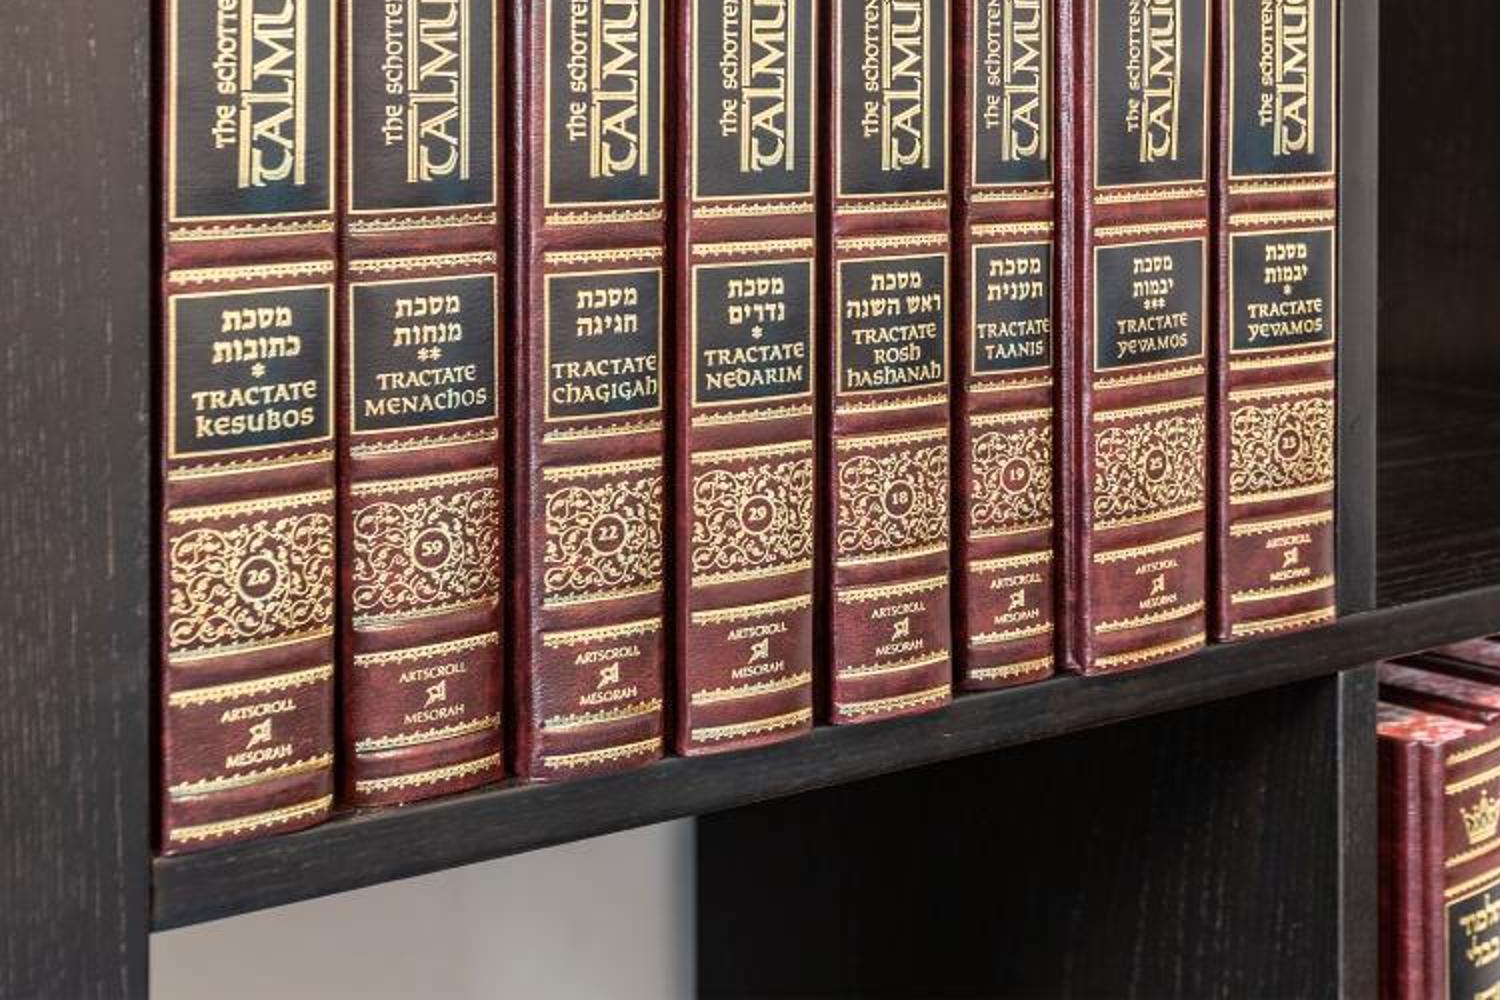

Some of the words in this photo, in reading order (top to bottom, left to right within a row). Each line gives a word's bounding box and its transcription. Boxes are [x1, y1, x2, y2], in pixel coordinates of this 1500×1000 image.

[989, 257, 1041, 277] מסכת
[728, 278, 785, 298] מסכת
[870, 271, 922, 292] מסכת
[987, 281, 1043, 300] תענית
[395, 295, 460, 319] מסכת
[577, 286, 638, 309] מסכת
[905, 294, 941, 313] ראש
[221, 305, 292, 332] מסכת
[728, 303, 785, 325] נדרים
[846, 297, 902, 320] השנה
[1247, 298, 1322, 319] TRACTATE
[576, 313, 638, 338] חגיגה
[852, 323, 936, 344] TRACTATE
[978, 317, 1049, 339] TRACTATE
[1117, 314, 1188, 334] TRACTATE
[393, 323, 462, 348] מנחות
[212, 333, 300, 365] כתובות
[704, 342, 803, 365] TRACTATE
[986, 341, 1043, 359] TAANIS
[552, 353, 656, 380] TRACTATE
[376, 365, 476, 392] TRACTATE
[192, 379, 316, 412] TRACTATE
[1010, 468, 1024, 482] 19
[748, 505, 766, 522] 29
[422, 539, 442, 557] 59
[245, 568, 271, 586] 26
[871, 602, 925, 620] ARTSCROLL
[727, 621, 788, 641] ARTSCROLL
[574, 645, 640, 666] ARTSCROLL
[875, 639, 924, 657] MESORAH
[398, 661, 466, 682] ARTSCROLL
[731, 659, 784, 679] MESORAH
[580, 686, 637, 706] MESORAH
[220, 699, 296, 723] ARTSCROLL
[403, 703, 465, 725] MESORAH
[226, 743, 292, 768] MESORAH
